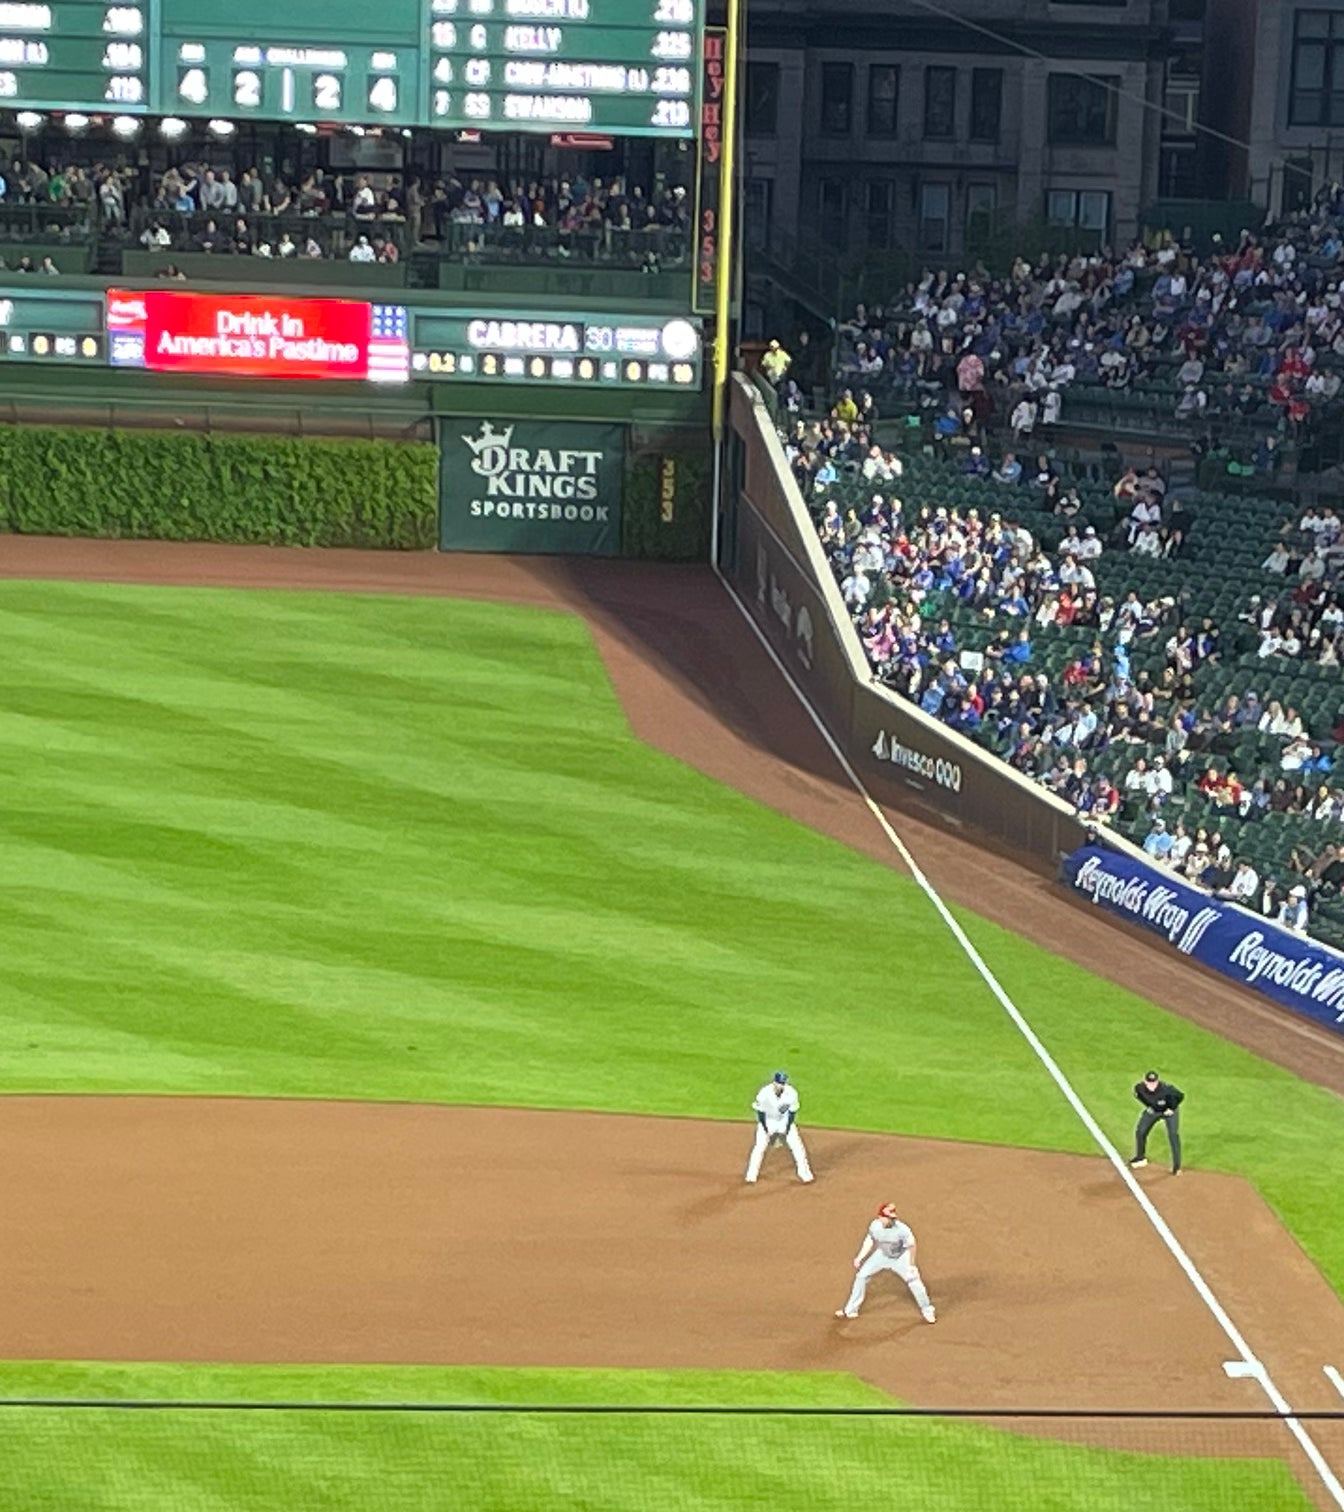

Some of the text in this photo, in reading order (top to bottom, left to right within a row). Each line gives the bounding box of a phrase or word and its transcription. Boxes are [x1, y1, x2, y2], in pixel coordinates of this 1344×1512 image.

[505, 25, 562, 52] KELLY
[178, 68, 209, 104] 4
[234, 70, 262, 106] 2
[314, 74, 342, 109] 2
[368, 77, 397, 112] 4
[216, 310, 304, 337] Drink in
[467, 320, 580, 351] CABRERA
[157, 331, 265, 358] America's
[269, 337, 359, 363] Pastime
[483, 354, 497, 375] 2
[470, 446, 603, 476] DRAFT
[487, 471, 597, 499] KINGS
[661, 458, 674, 523] 353
[470, 499, 608, 522] SPORTSBOOK
[1075, 855, 1190, 942] Reynolds Wrap
[1229, 930, 1324, 995] Reynolds
